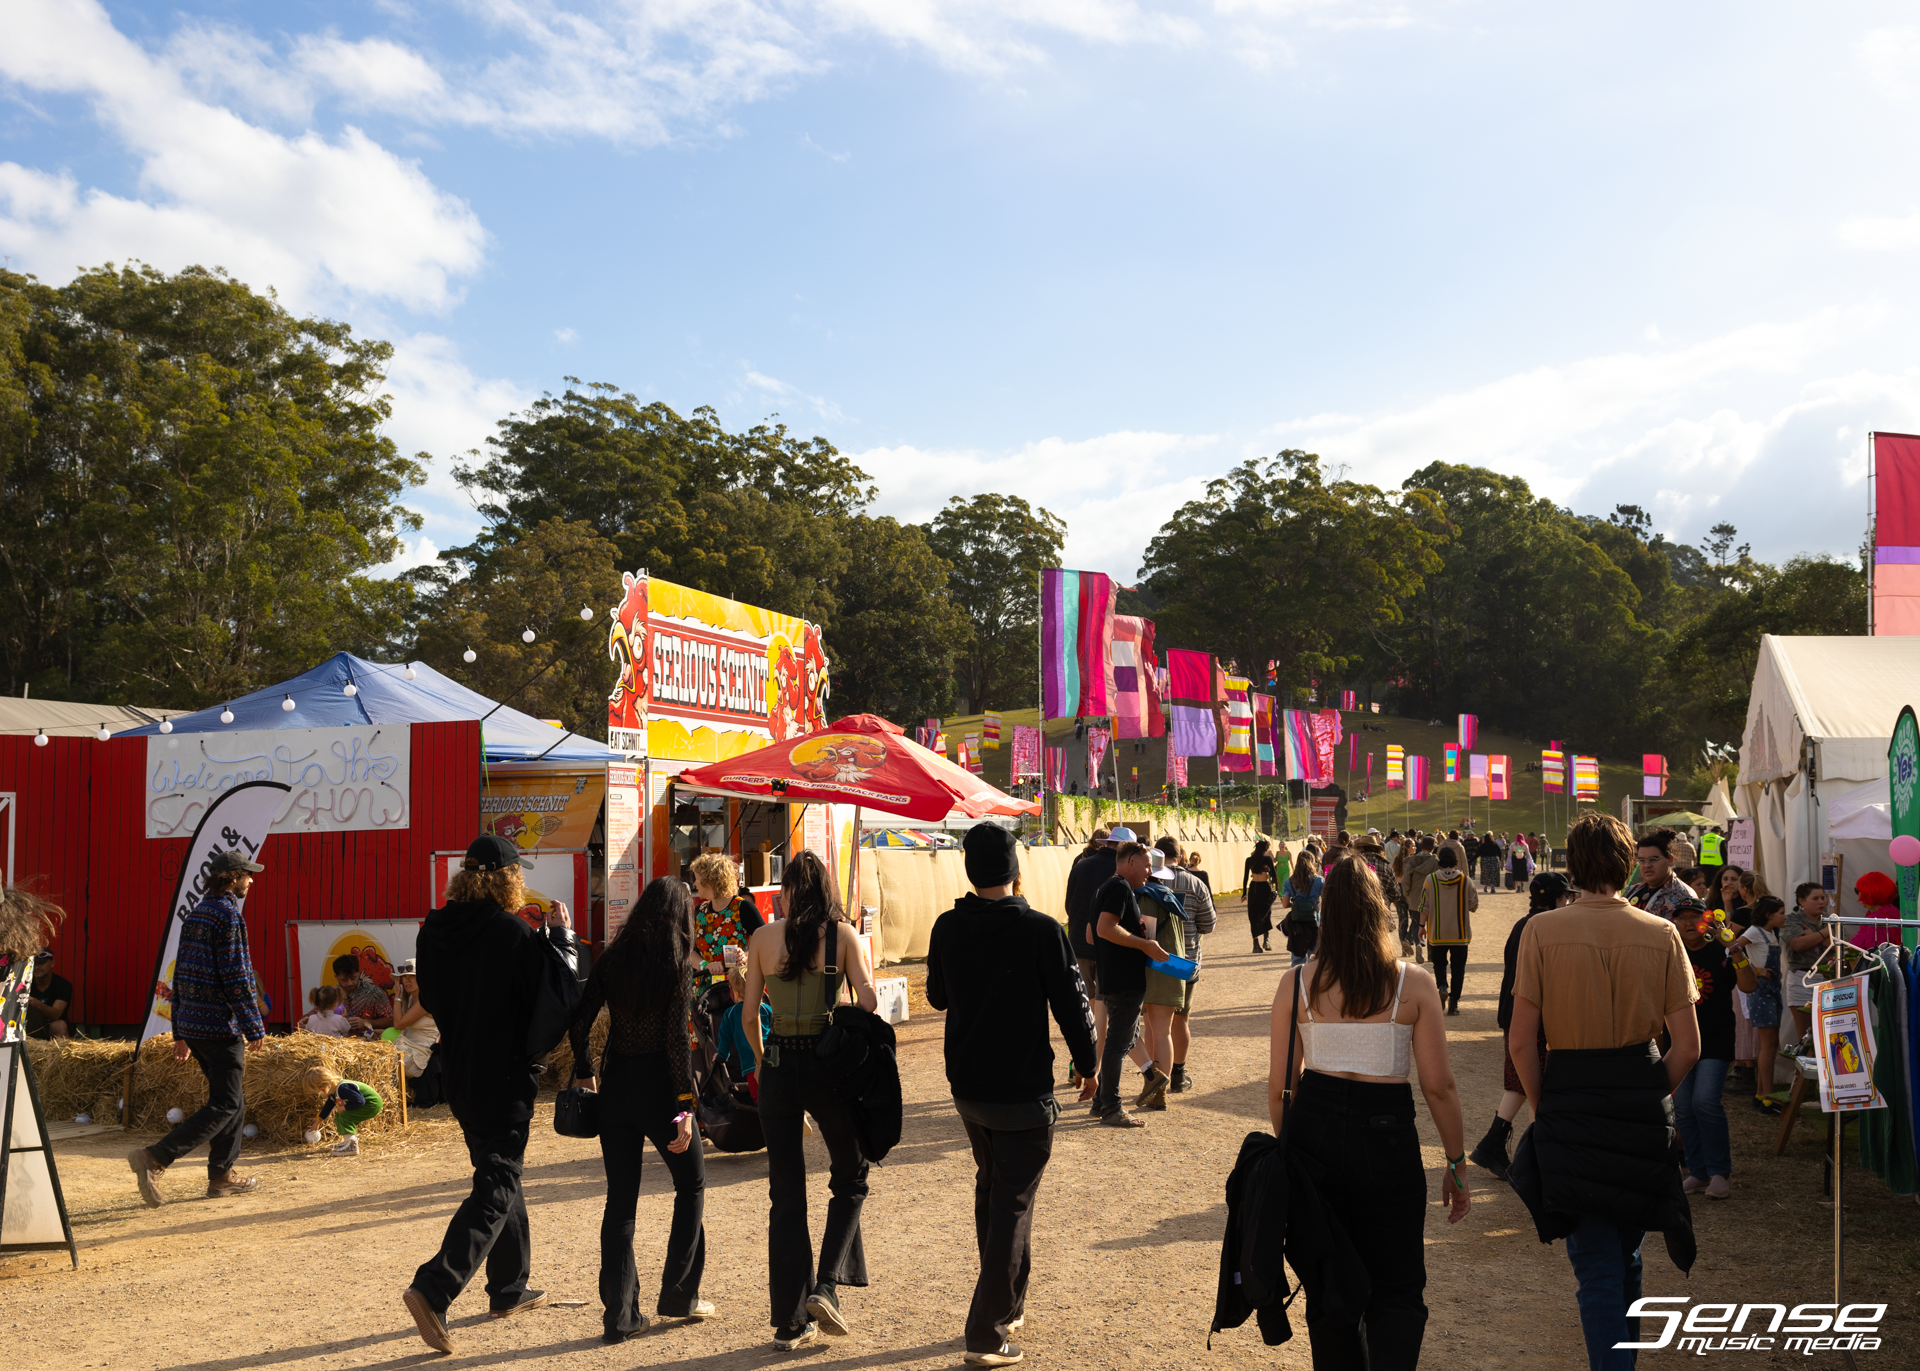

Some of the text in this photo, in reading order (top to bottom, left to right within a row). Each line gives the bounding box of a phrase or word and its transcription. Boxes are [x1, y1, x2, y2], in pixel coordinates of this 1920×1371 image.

[652, 631, 770, 718] SERIOUS SCHNIT
[610, 730, 621, 750] EAT
[1896, 752, 1913, 785] Yes
[722, 775, 766, 784] BURGERS
[842, 786, 874, 797] SNACK
[876, 793, 909, 803] PACKS
[481, 794, 570, 813] SERIOUS SCHNIT
